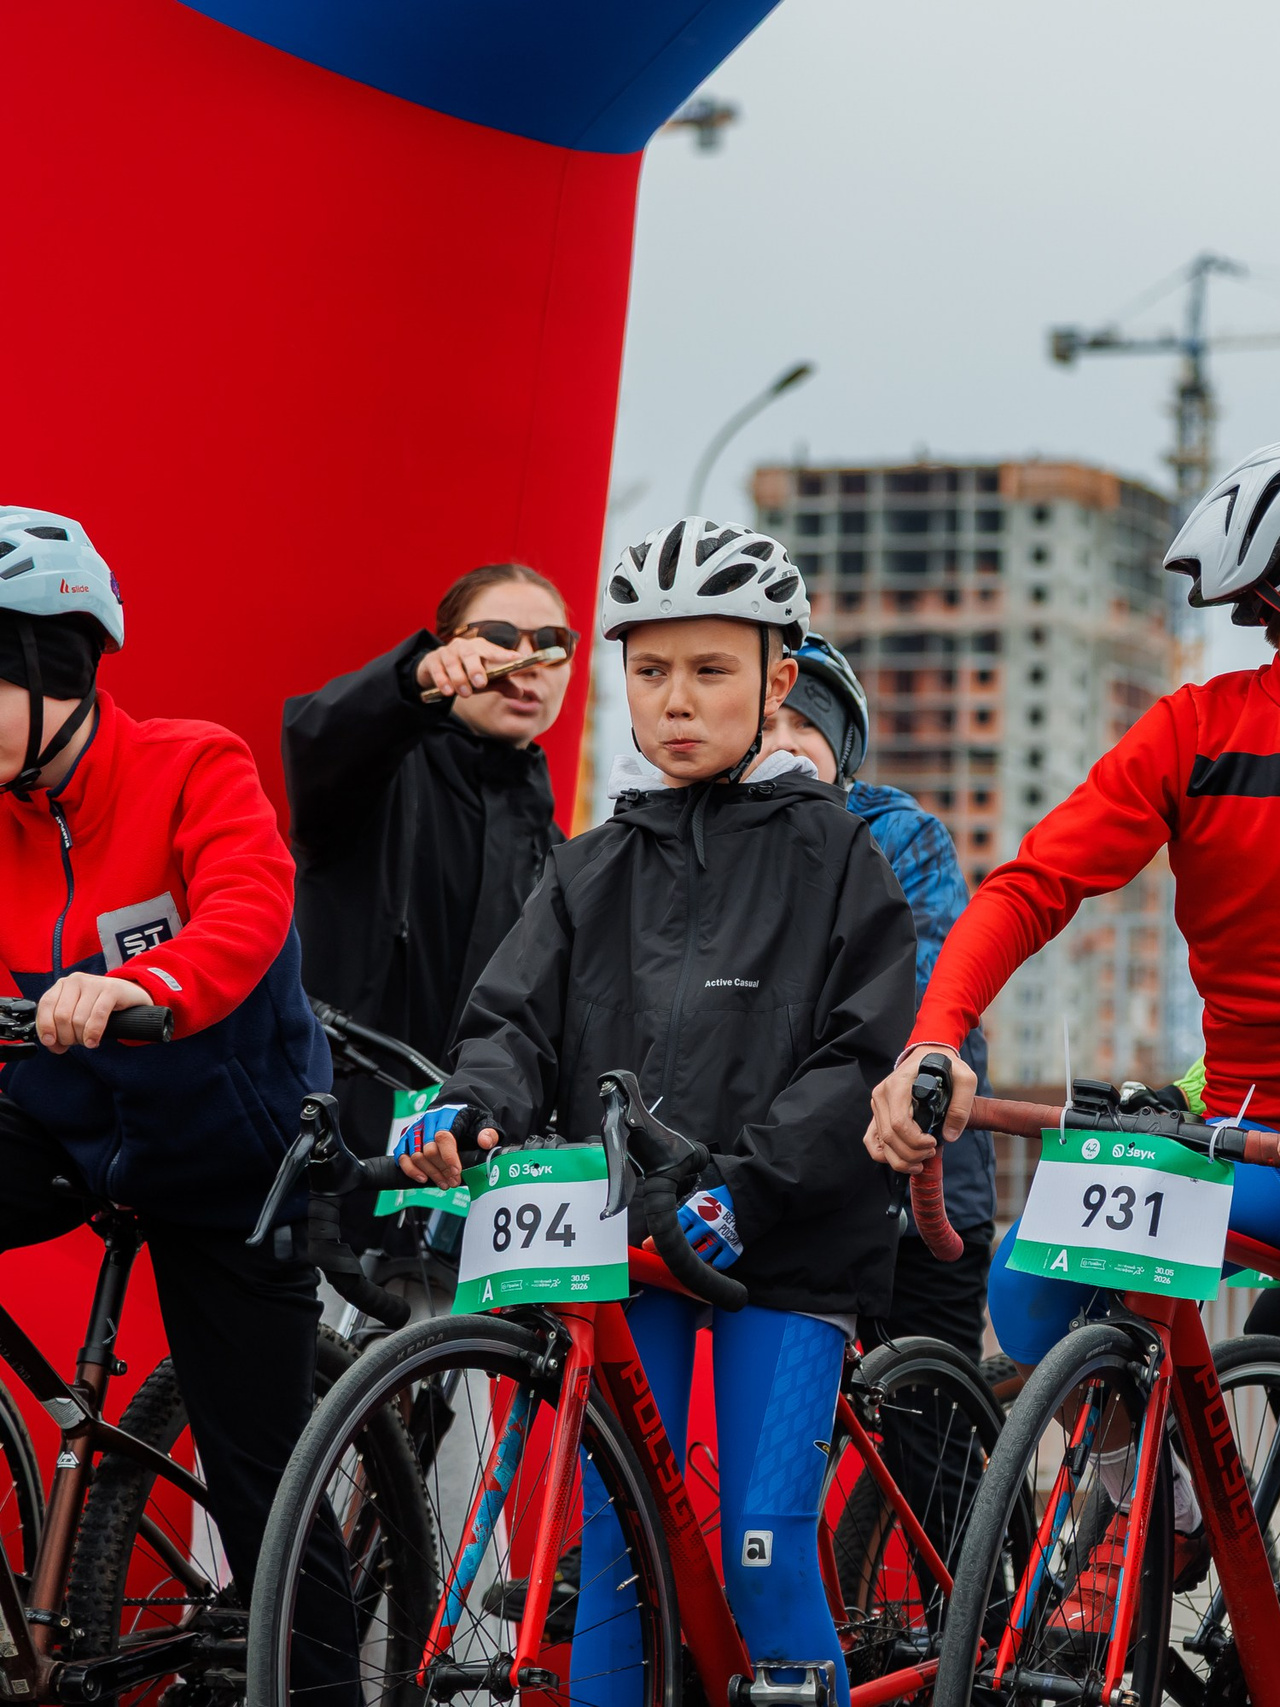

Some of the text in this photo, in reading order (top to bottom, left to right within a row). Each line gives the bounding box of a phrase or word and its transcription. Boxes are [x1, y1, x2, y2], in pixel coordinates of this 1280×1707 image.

[704, 978, 760, 988] Active Casual
[1126, 1145, 1156, 1160] Звук
[1081, 1183, 1164, 1238] 931
[493, 1202, 576, 1256] 894
[1050, 1248, 1069, 1272] A
[571, 1274, 590, 1282] 30.05
[1154, 1266, 1175, 1277] 30.05
[570, 1283, 588, 1291] 2026
[1153, 1275, 1172, 1285] 2026
[482, 1279, 494, 1303] A
[397, 1333, 444, 1361] KENDA
